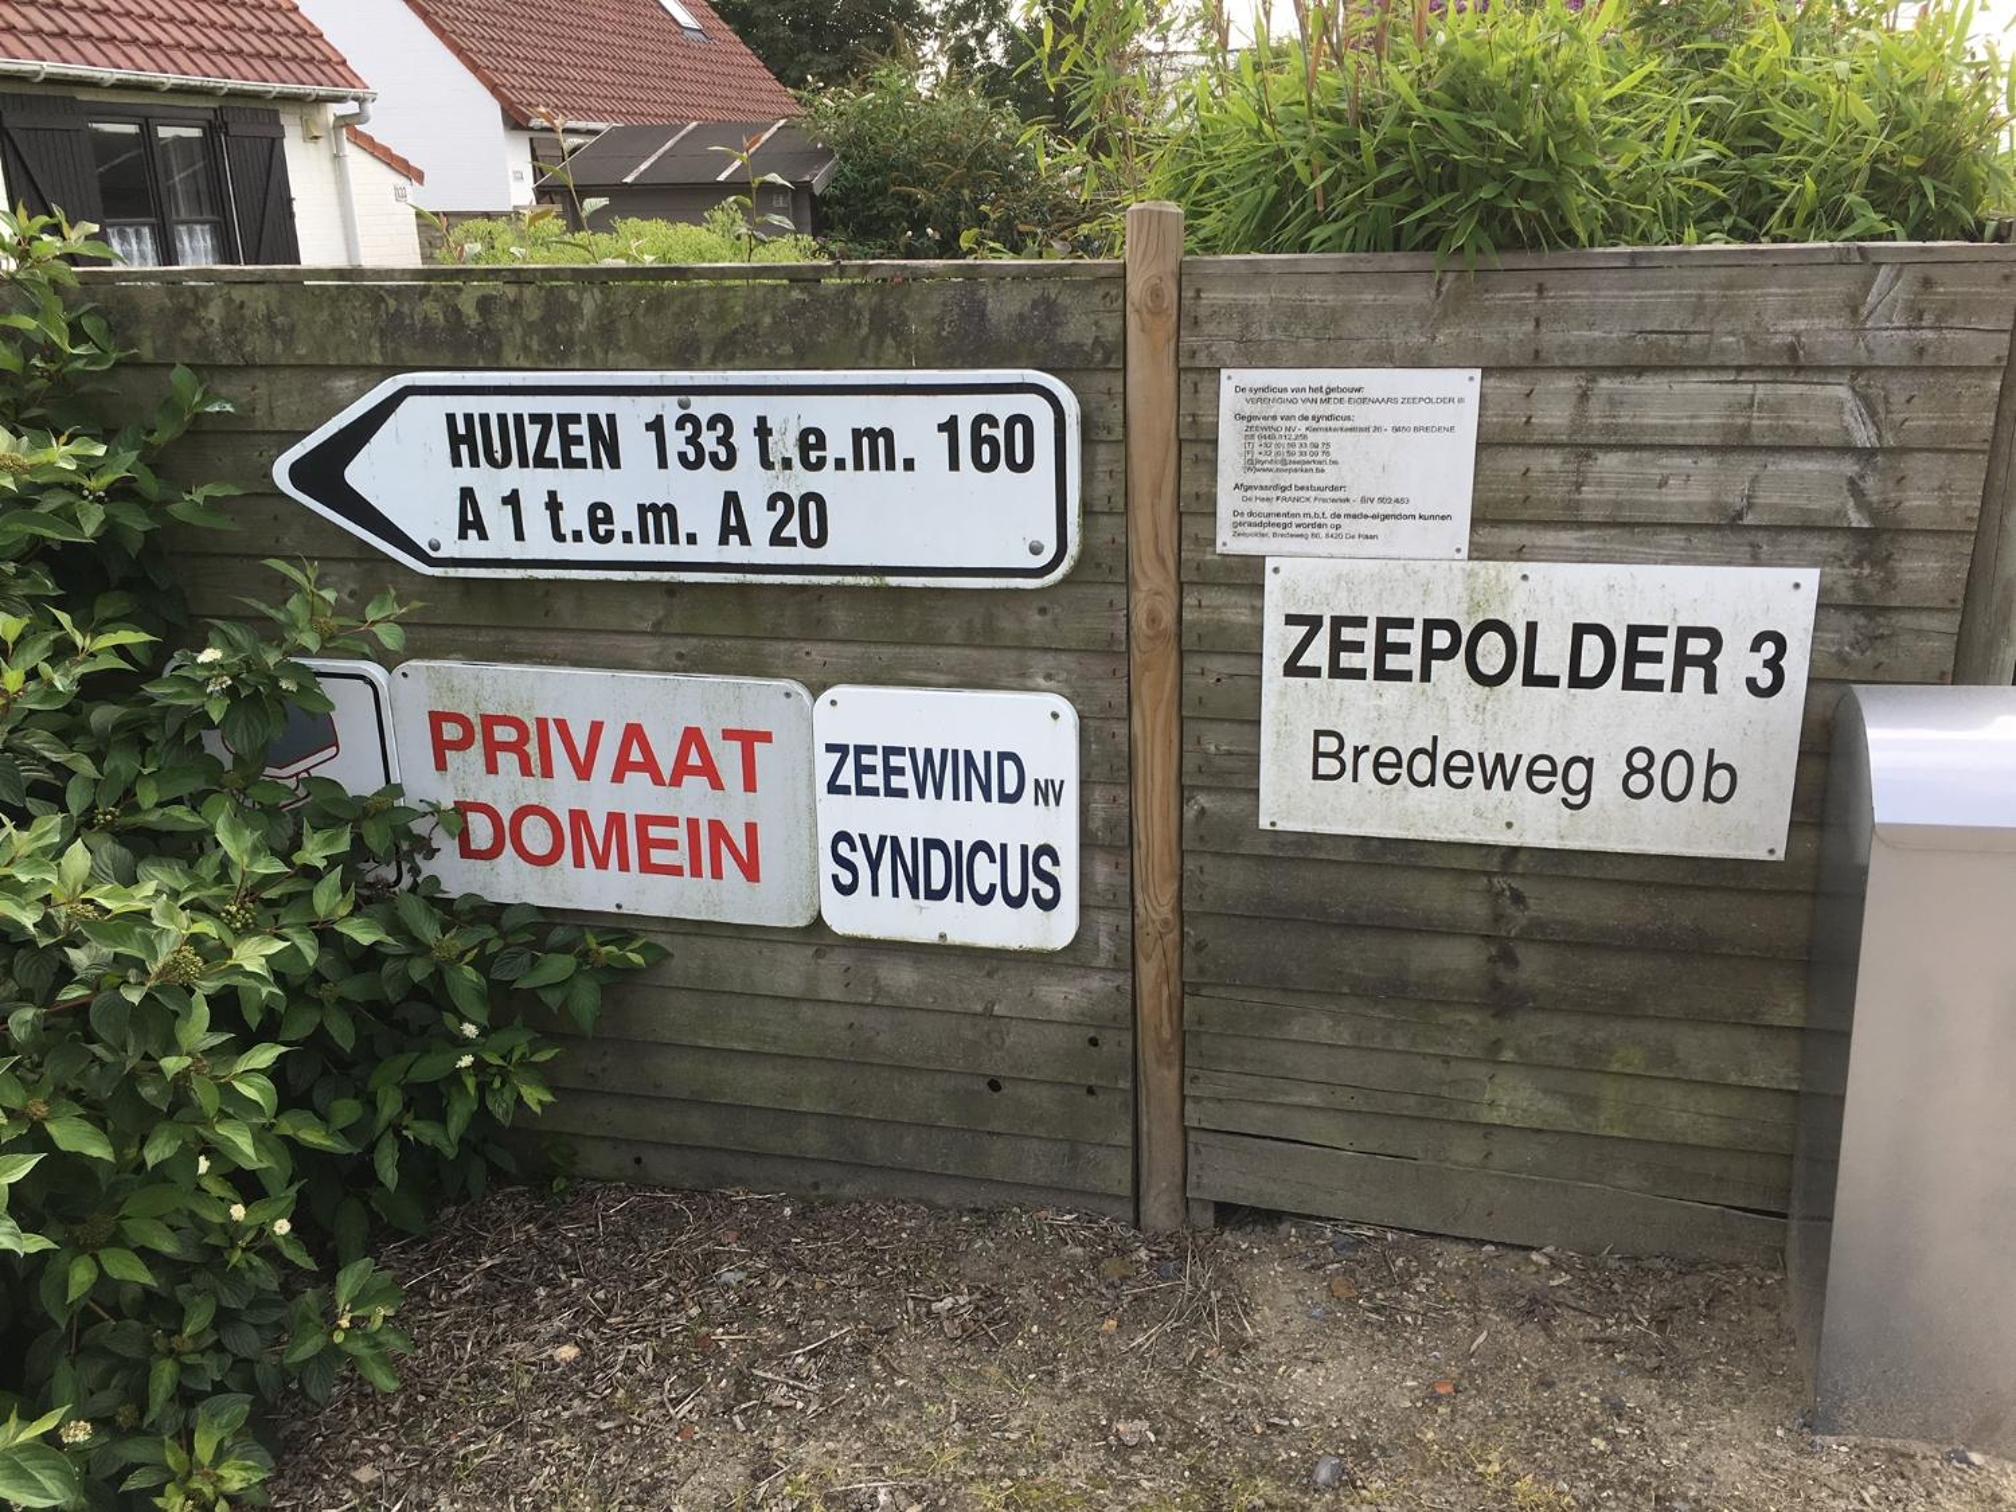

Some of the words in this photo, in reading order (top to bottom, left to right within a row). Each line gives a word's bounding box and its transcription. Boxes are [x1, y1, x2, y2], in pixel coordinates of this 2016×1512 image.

[1234, 385, 1246, 394] De
[1248, 385, 1288, 395] syndicus
[1290, 386, 1306, 394] van
[1309, 385, 1323, 394] het
[1234, 413, 1277, 422] Gegevens
[1298, 413, 1309, 421] de
[1300, 397, 1318, 405] VAN
[1320, 397, 1345, 405] MEDE
[1348, 397, 1399, 405] EIGENAARS
[1401, 397, 1455, 405] ZEEPOLDER
[445, 412, 621, 471] HUIZEN
[645, 412, 739, 473] 133
[754, 414, 915, 474] t.e.m.
[936, 413, 1036, 475] 160
[457, 486, 489, 541] A
[502, 486, 524, 542] 1
[544, 490, 698, 546] t.e.m.
[718, 490, 750, 546] A
[766, 491, 829, 549] 20
[1233, 483, 1292, 493] Afgevaardigd
[1233, 510, 1245, 518] De
[1246, 510, 1301, 518] documenten
[1330, 511, 1341, 519] de
[1343, 512, 1415, 522] mede-eigendom
[1418, 512, 1452, 520] kunnen
[1232, 521, 1293, 530] geraadpleegd
[1282, 613, 1724, 695] ZEEPOLDER
[1745, 629, 1789, 699] 3
[428, 709, 774, 795] PRIVAAT
[824, 742, 1026, 805] ZEEWIND
[1033, 778, 1066, 808] NV
[1311, 729, 1595, 811] Bredeweg
[453, 800, 761, 884] DOMEIN
[830, 830, 1063, 912] SYNDICUS
